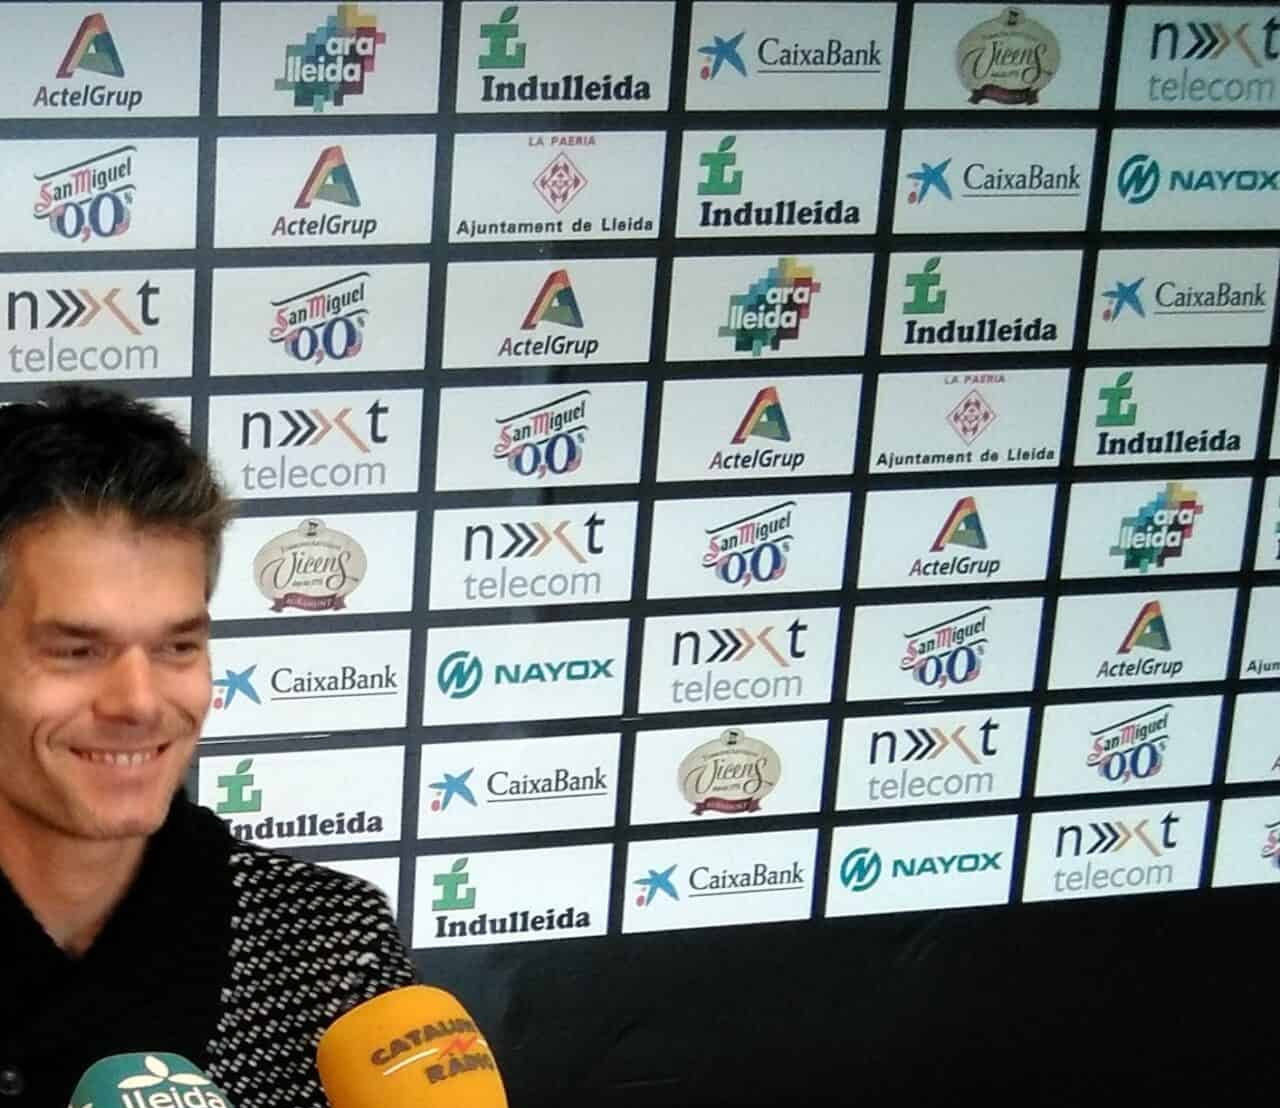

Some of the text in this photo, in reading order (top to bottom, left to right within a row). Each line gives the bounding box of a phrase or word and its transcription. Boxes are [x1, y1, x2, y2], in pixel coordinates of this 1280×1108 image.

[325, 36, 376, 56] ara
[758, 37, 881, 67] CaixaBank
[285, 56, 361, 84] lleida
[481, 74, 650, 102] Indulleida
[1148, 67, 1275, 102] telecom
[34, 86, 143, 111] ActelGrup
[529, 136, 596, 146] LA PAERIA
[962, 163, 1080, 190] CaixaBank
[1170, 170, 1280, 191] NAYOX
[272, 215, 377, 238] ActelGrup
[456, 217, 653, 237] Ajuntament de Lleida
[699, 201, 860, 227] Indulleida
[765, 284, 810, 305] ara
[1155, 281, 1266, 308] CaixaBank
[728, 303, 798, 329] lleida
[904, 320, 1058, 345] Indulleida
[10, 340, 158, 373] telecom
[498, 336, 599, 358] ActelGrup
[1097, 430, 1240, 454] Indulleida
[708, 449, 804, 471] ActelGrup
[876, 447, 1055, 466] Ajuntament de Lleida
[242, 459, 386, 490] telecom
[1152, 507, 1195, 526] ara
[1120, 526, 1182, 548] lleida
[909, 556, 1000, 577] ActelGrup
[464, 566, 601, 600] telecom
[270, 665, 397, 693] CaixaBank
[495, 659, 614, 684] NAYOX
[1097, 658, 1183, 679] ActelGrup
[673, 673, 802, 703] telecom
[487, 768, 607, 797] CaixaBank
[868, 768, 993, 800] telecom
[689, 862, 803, 891] CaixaBank
[893, 851, 1001, 879] NAYOX
[1053, 861, 1173, 892] telecom
[435, 908, 590, 938] Indulleida
